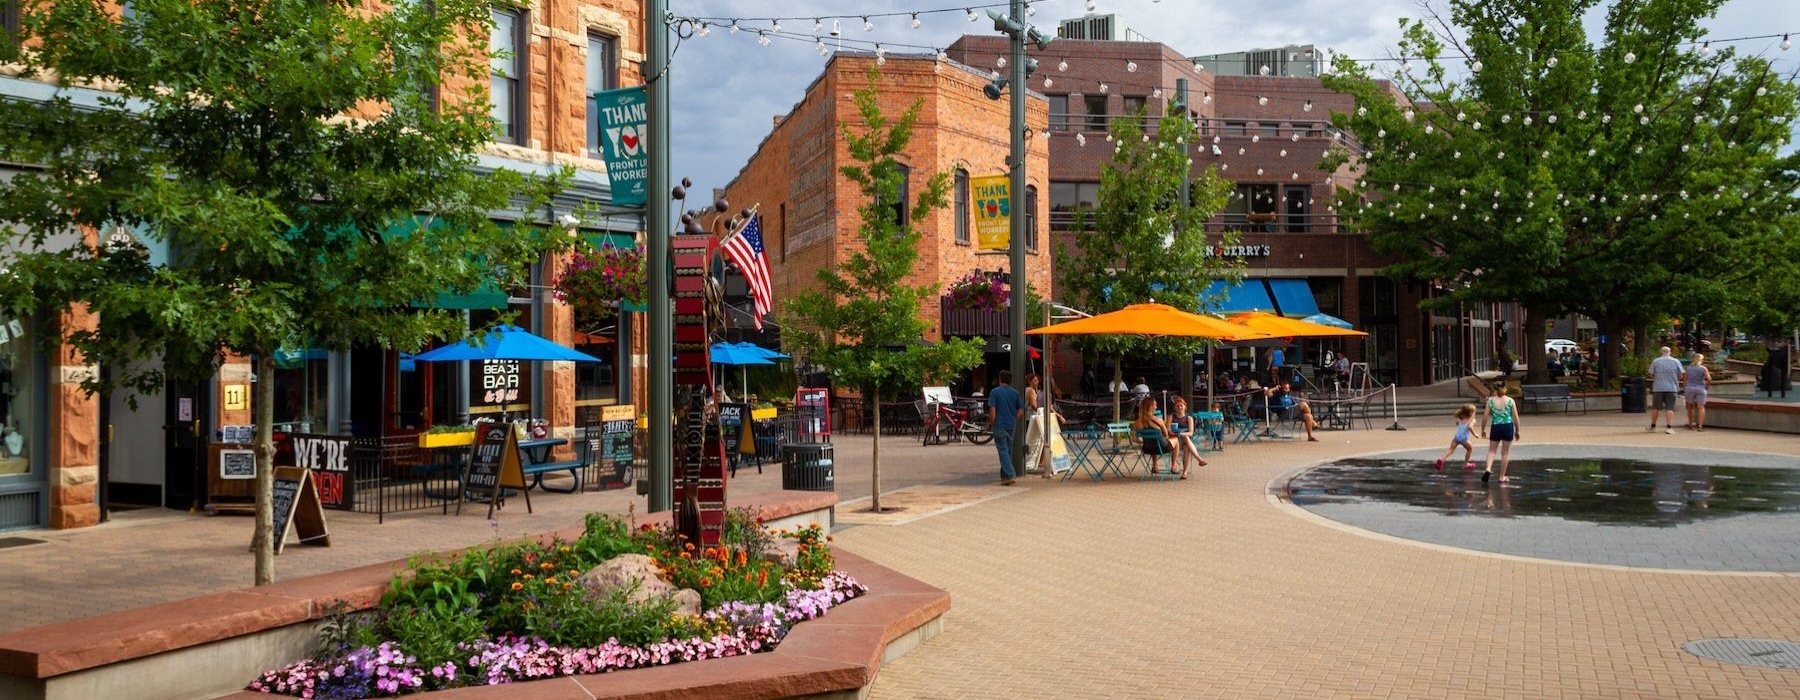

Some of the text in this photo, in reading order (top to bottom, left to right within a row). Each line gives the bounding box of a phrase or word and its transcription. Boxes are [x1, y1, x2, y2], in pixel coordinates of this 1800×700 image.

[610, 159, 638, 171] FRONT
[611, 168, 647, 181] WORKE
[975, 185, 1008, 197] THANK
[977, 198, 1010, 219] YOU
[111, 233, 130, 242] OLD
[1223, 244, 1270, 256] JERRY'S
[484, 364, 519, 374] BEACH
[484, 374, 519, 388] BAR
[227, 390, 239, 404] 11
[720, 405, 741, 416] JACK
[294, 437, 349, 472] WE'RE
